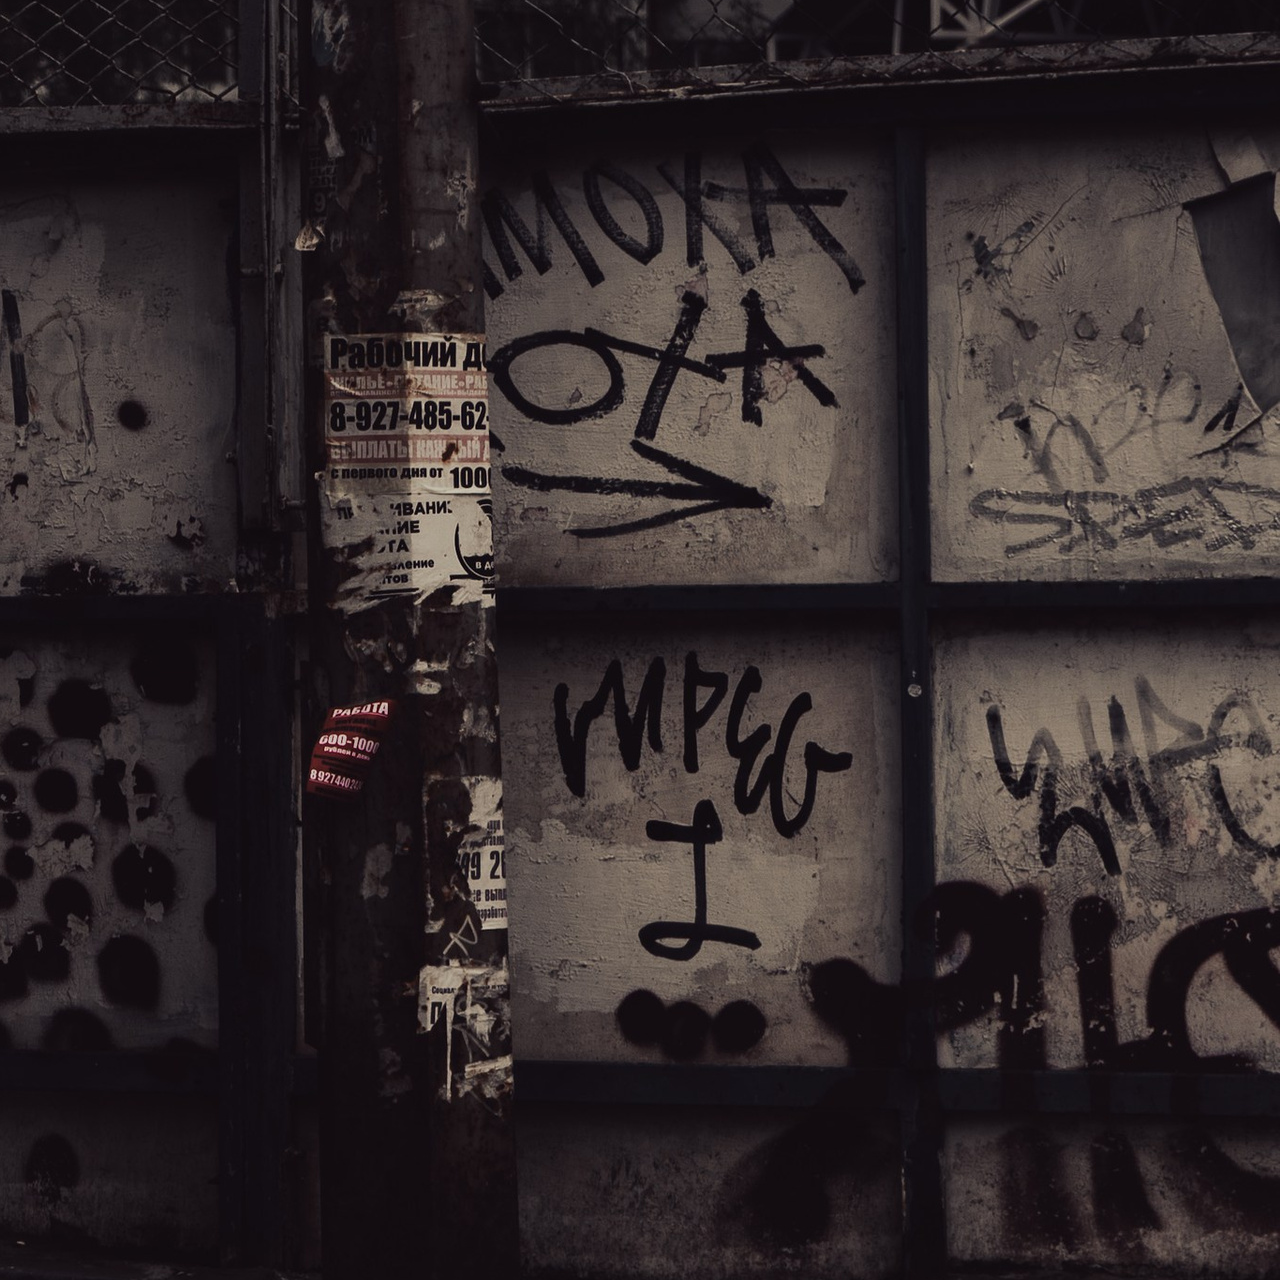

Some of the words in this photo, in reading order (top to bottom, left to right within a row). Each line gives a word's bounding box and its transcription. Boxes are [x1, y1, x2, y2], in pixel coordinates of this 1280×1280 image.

[330, 335, 456, 370] Рабочий
[341, 468, 399, 480] первого
[400, 468, 427, 480] дня
[430, 468, 444, 478] от
[332, 701, 390, 718] РАБОТА
[318, 733, 380, 754] 600-1000
